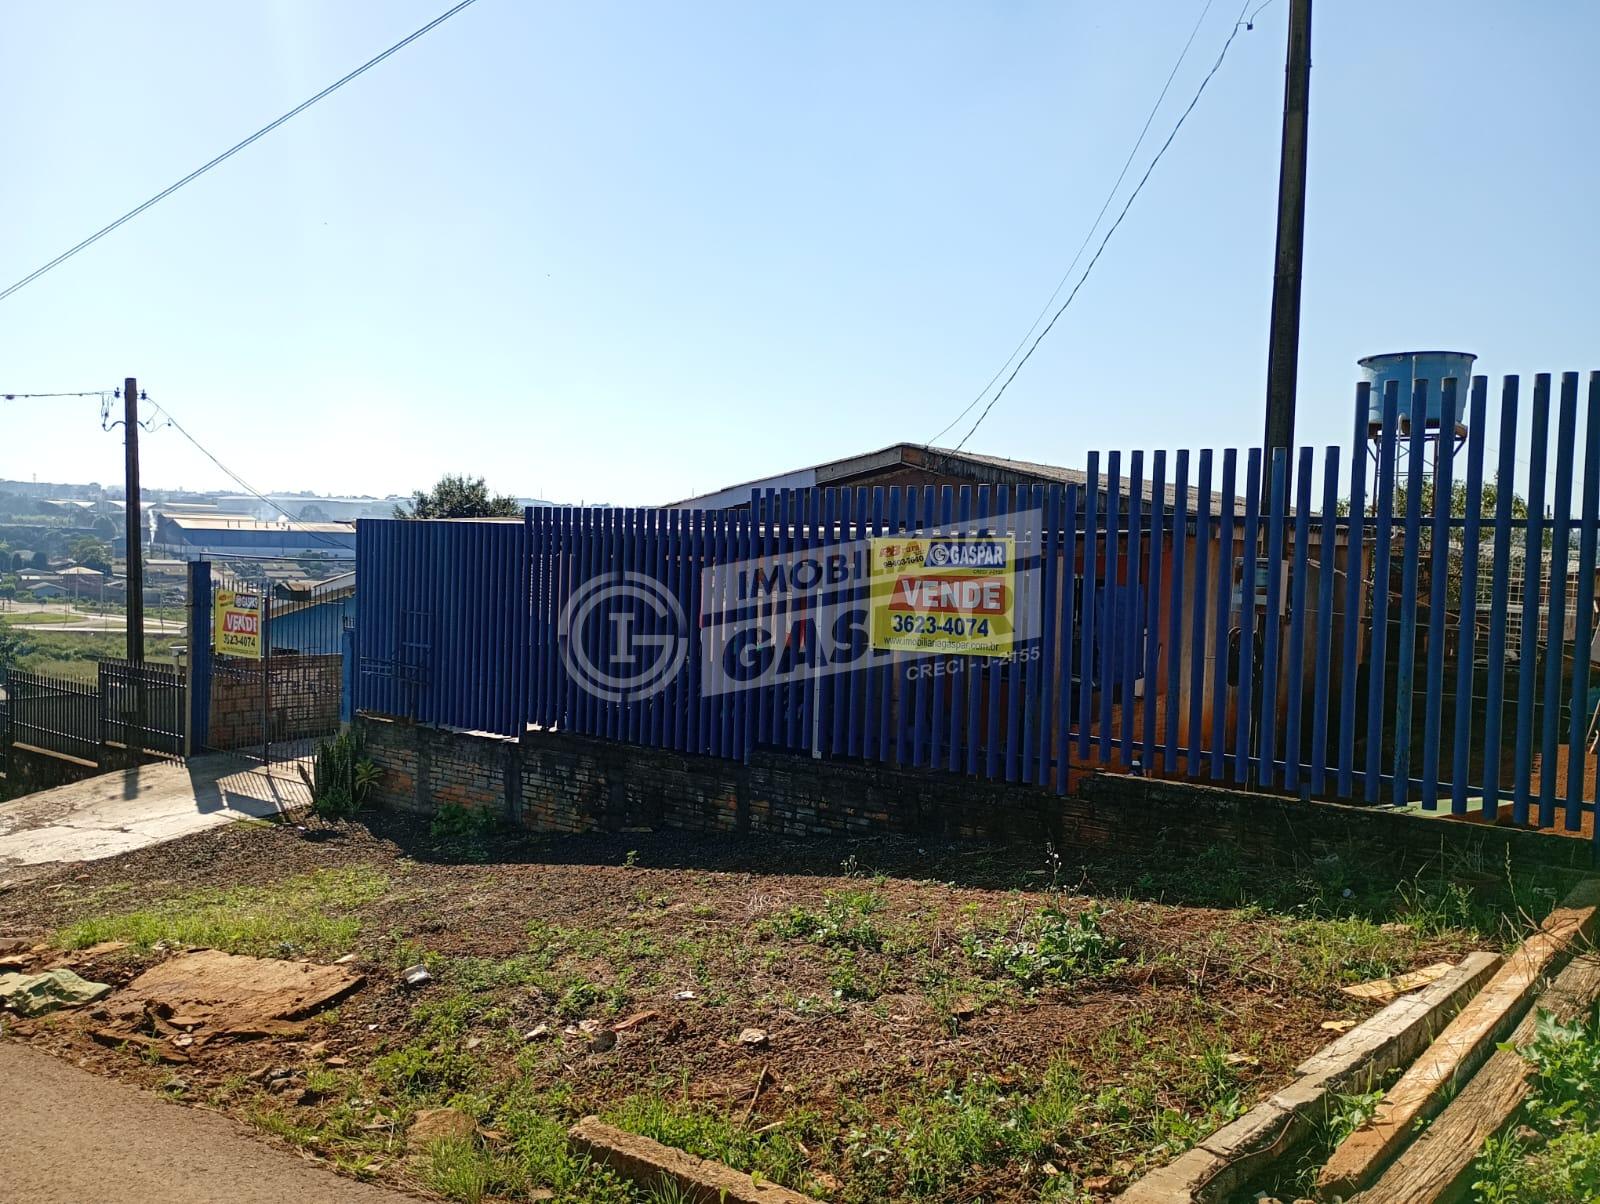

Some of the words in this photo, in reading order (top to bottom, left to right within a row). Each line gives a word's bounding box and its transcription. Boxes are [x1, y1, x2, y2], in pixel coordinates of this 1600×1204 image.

[951, 545, 1003, 566] GASPAR
[902, 579, 1001, 610] VENDE
[893, 614, 988, 637] 3623-4074
